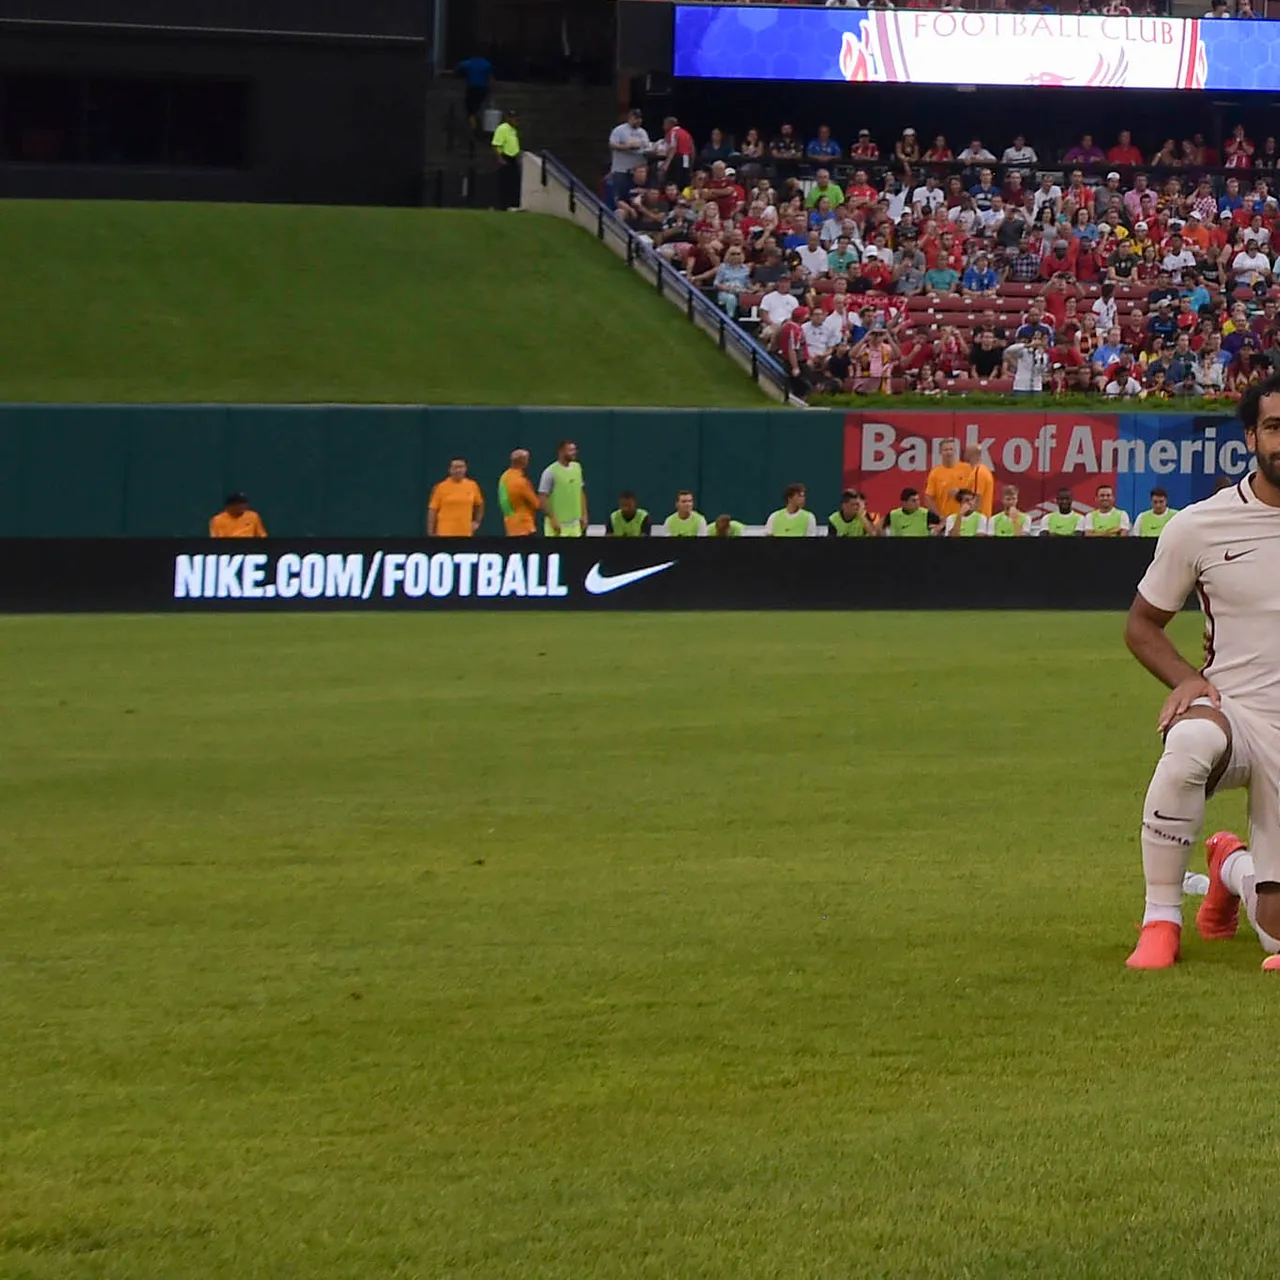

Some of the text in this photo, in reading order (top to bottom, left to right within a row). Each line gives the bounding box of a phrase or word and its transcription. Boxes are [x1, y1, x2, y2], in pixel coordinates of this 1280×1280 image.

[914, 10, 1174, 45] FOOTBALL CLUB
[1002, 424, 1058, 473] of
[1061, 426, 1259, 475] Americ
[173, 550, 568, 600] NIKE.COM/FOOTBALL
